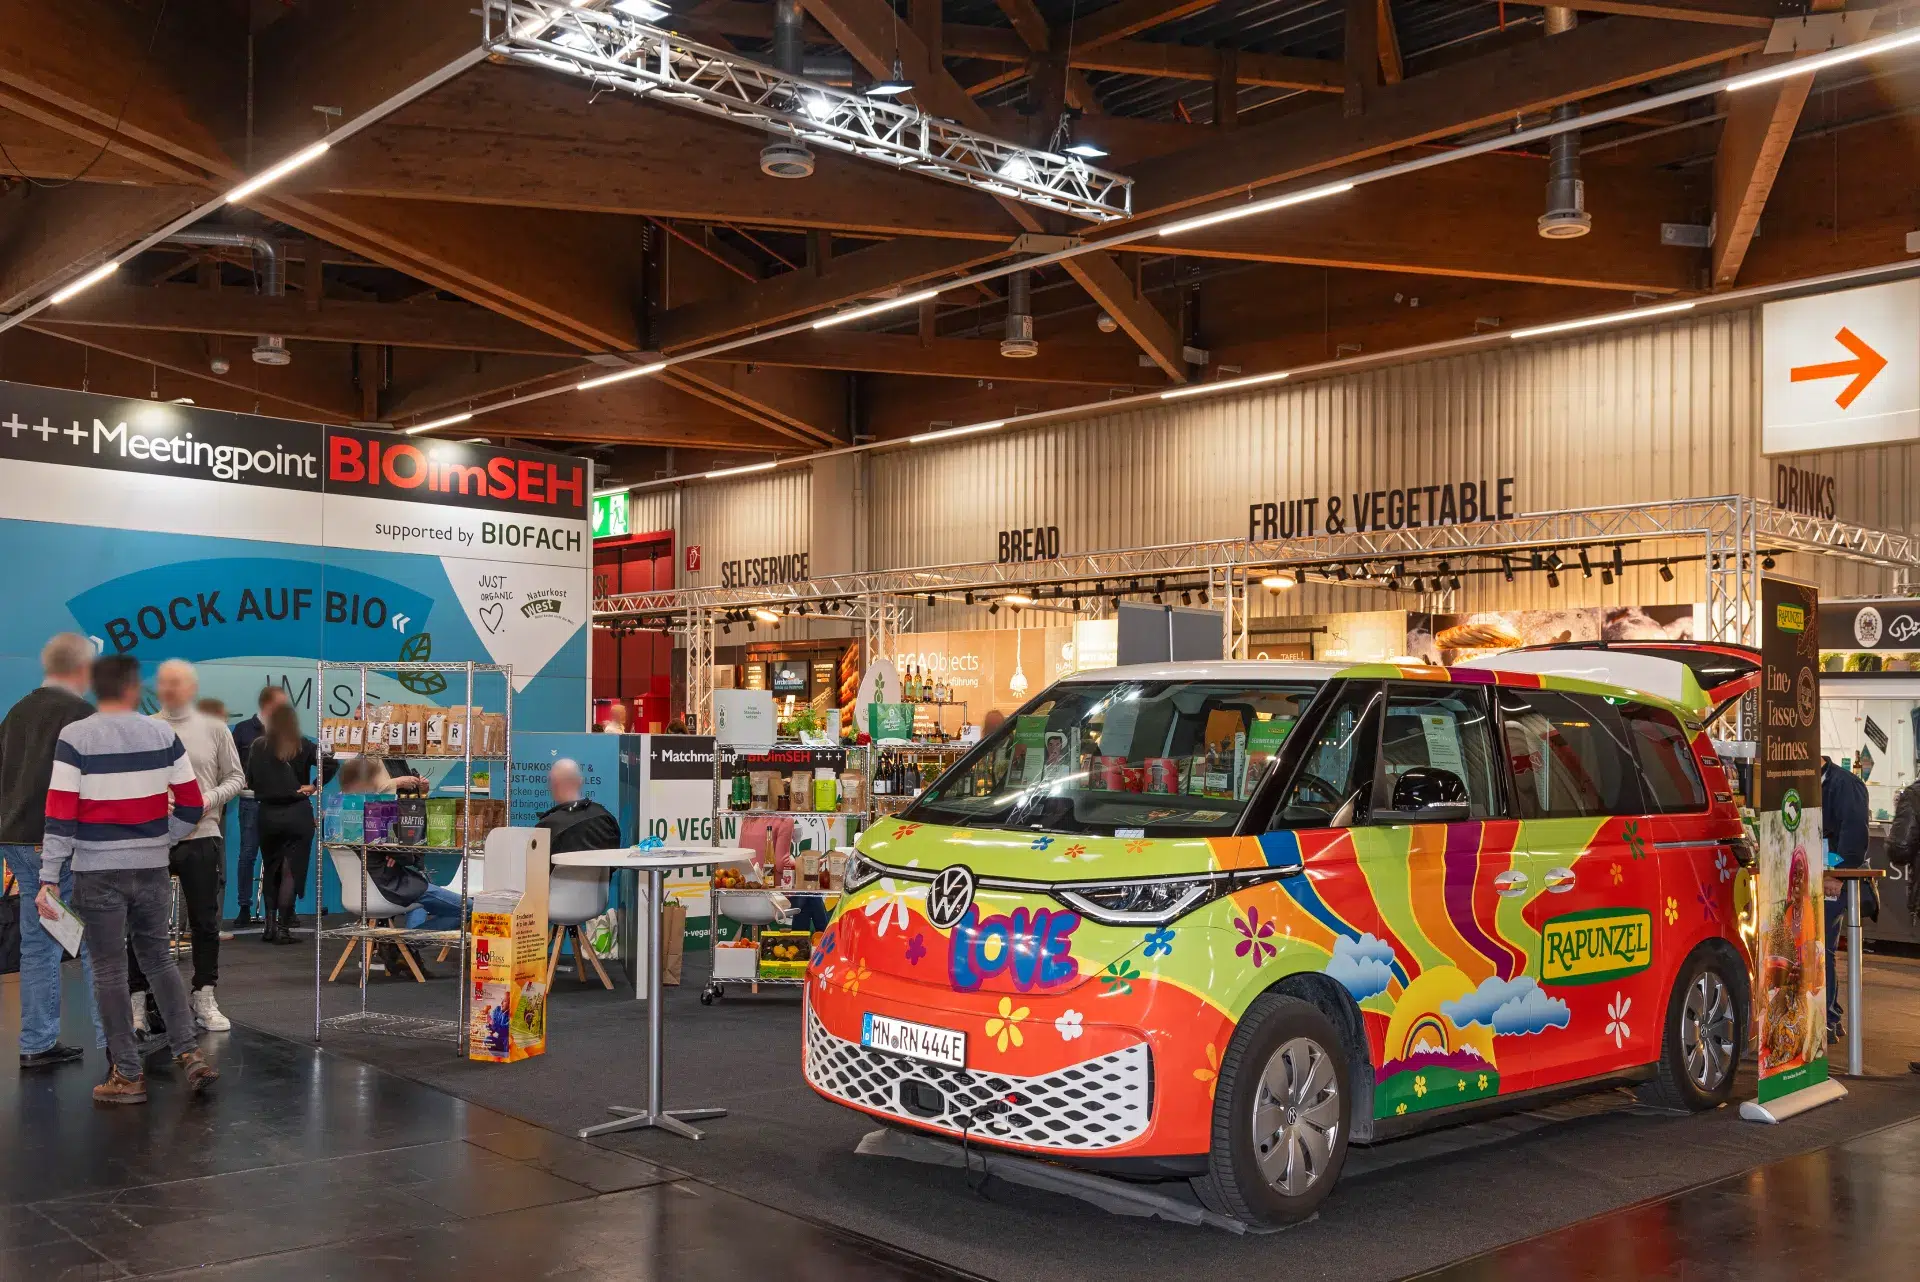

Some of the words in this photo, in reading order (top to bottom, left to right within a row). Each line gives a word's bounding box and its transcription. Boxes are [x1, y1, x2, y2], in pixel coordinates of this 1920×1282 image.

[329, 435, 583, 507] BIOimSEH
[1777, 464, 1835, 520] DRINKS
[1250, 497, 1319, 541] FRUIT
[1325, 495, 1346, 535] &
[1352, 477, 1514, 533] VEGETABLE
[375, 523, 452, 543] supported
[458, 527, 474, 547] by
[481, 522, 581, 552] BIOFACH
[998, 526, 1060, 564] BREAD
[478, 575, 507, 589] JUST
[721, 552, 808, 588] SELFSERVICE
[481, 591, 513, 601] ORGANIC
[524, 599, 554, 617] West
[526, 587, 567, 601] Naturkost
[104, 590, 227, 653] BOCK
[236, 588, 312, 621] AUF
[325, 591, 387, 628] BIO
[1778, 608, 1803, 627] RAPUNZEL
[1766, 664, 1790, 693] Eine
[1766, 700, 1798, 728] Tasse
[391, 728, 399, 738] S
[409, 726, 417, 737] H
[451, 727, 459, 738] R
[661, 749, 738, 766] Matchmaing
[1766, 735, 1809, 761] Fairness.
[949, 902, 1081, 993] LOVE
[1547, 922, 1648, 971] RAPUNZEL
[872, 1019, 890, 1047] MN
[899, 1025, 919, 1053] RN
[921, 1030, 962, 1062] 444E
